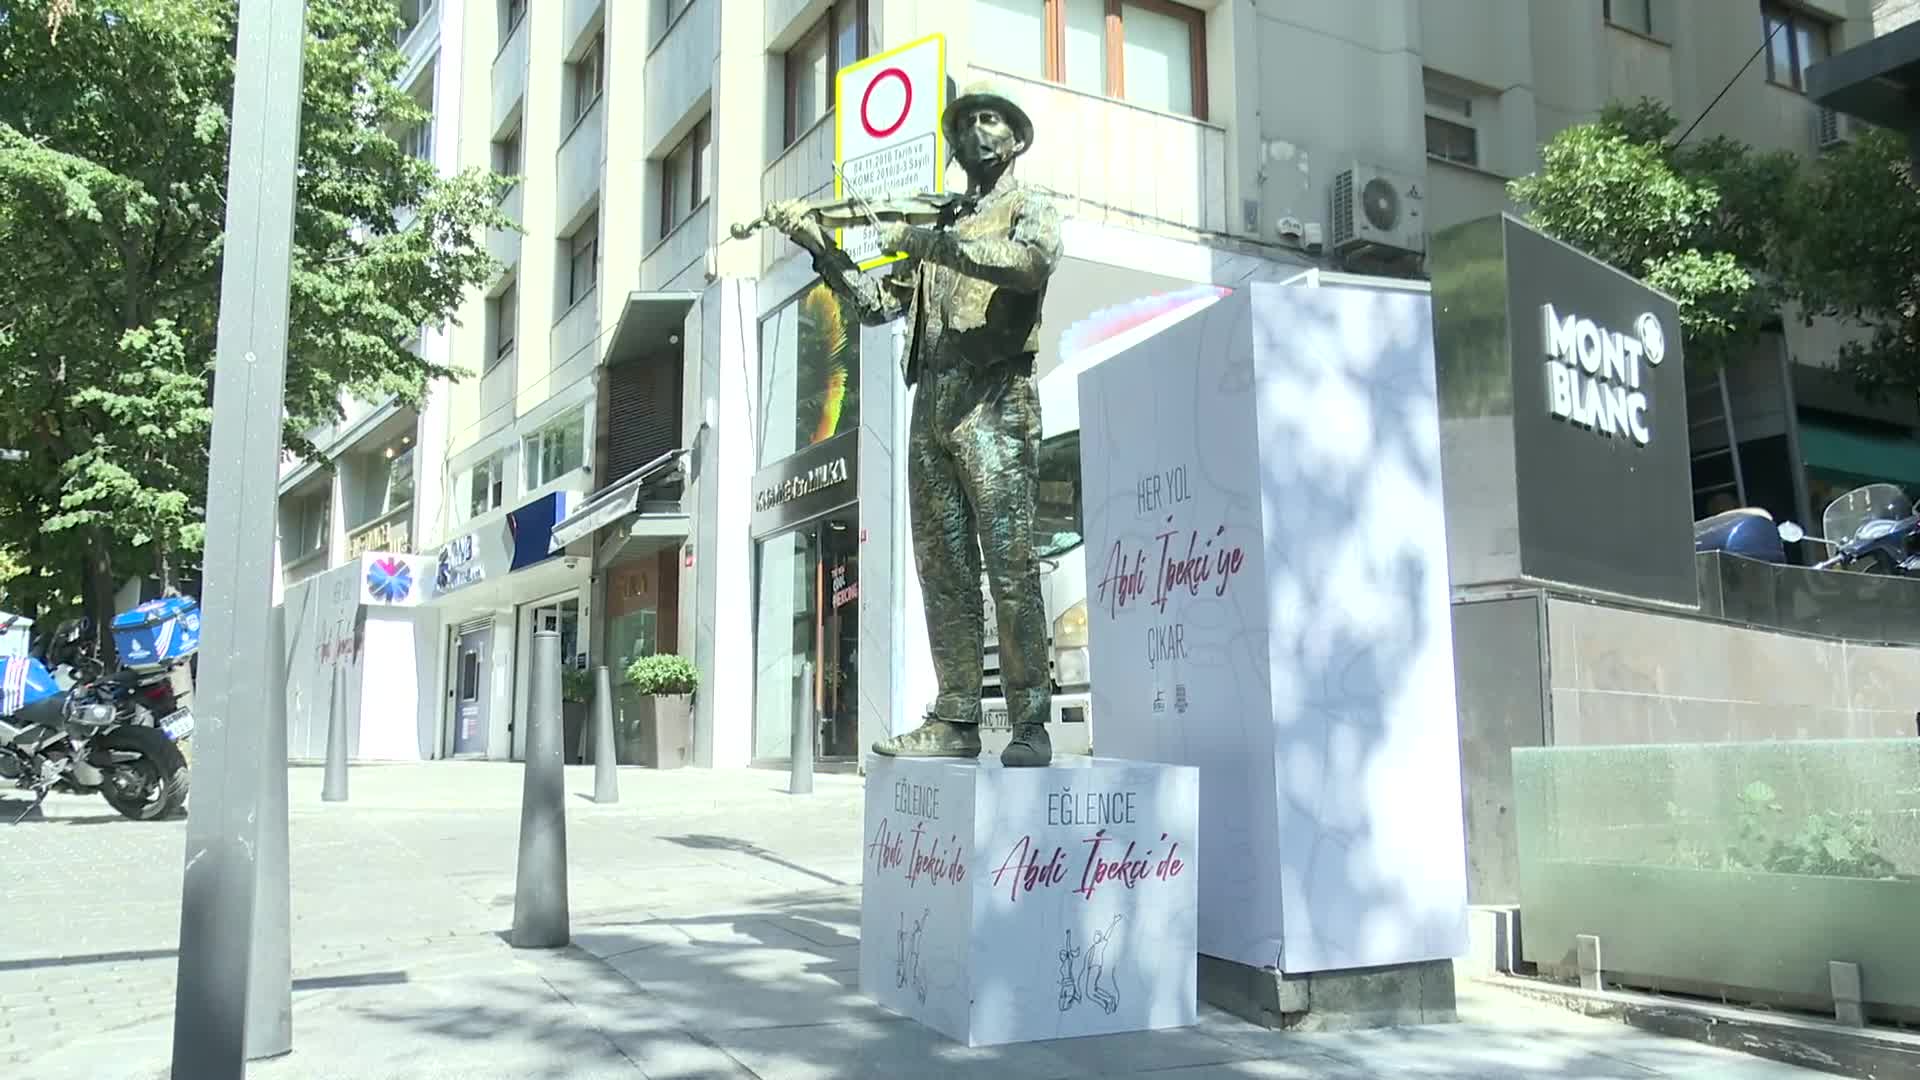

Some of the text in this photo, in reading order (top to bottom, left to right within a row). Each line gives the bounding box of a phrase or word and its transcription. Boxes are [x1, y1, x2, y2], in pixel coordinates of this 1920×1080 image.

[1542, 302, 1643, 389] MONT
[1545, 360, 1649, 444] BLANC
[1137, 463, 1191, 515] HER YOL
[1098, 540, 1145, 619] Abdi
[895, 778, 939, 820] EĞLENCE
[1048, 787, 1136, 826] EĞLENCE
[869, 818, 904, 876] Abdi
[992, 836, 1067, 902] Abdi
